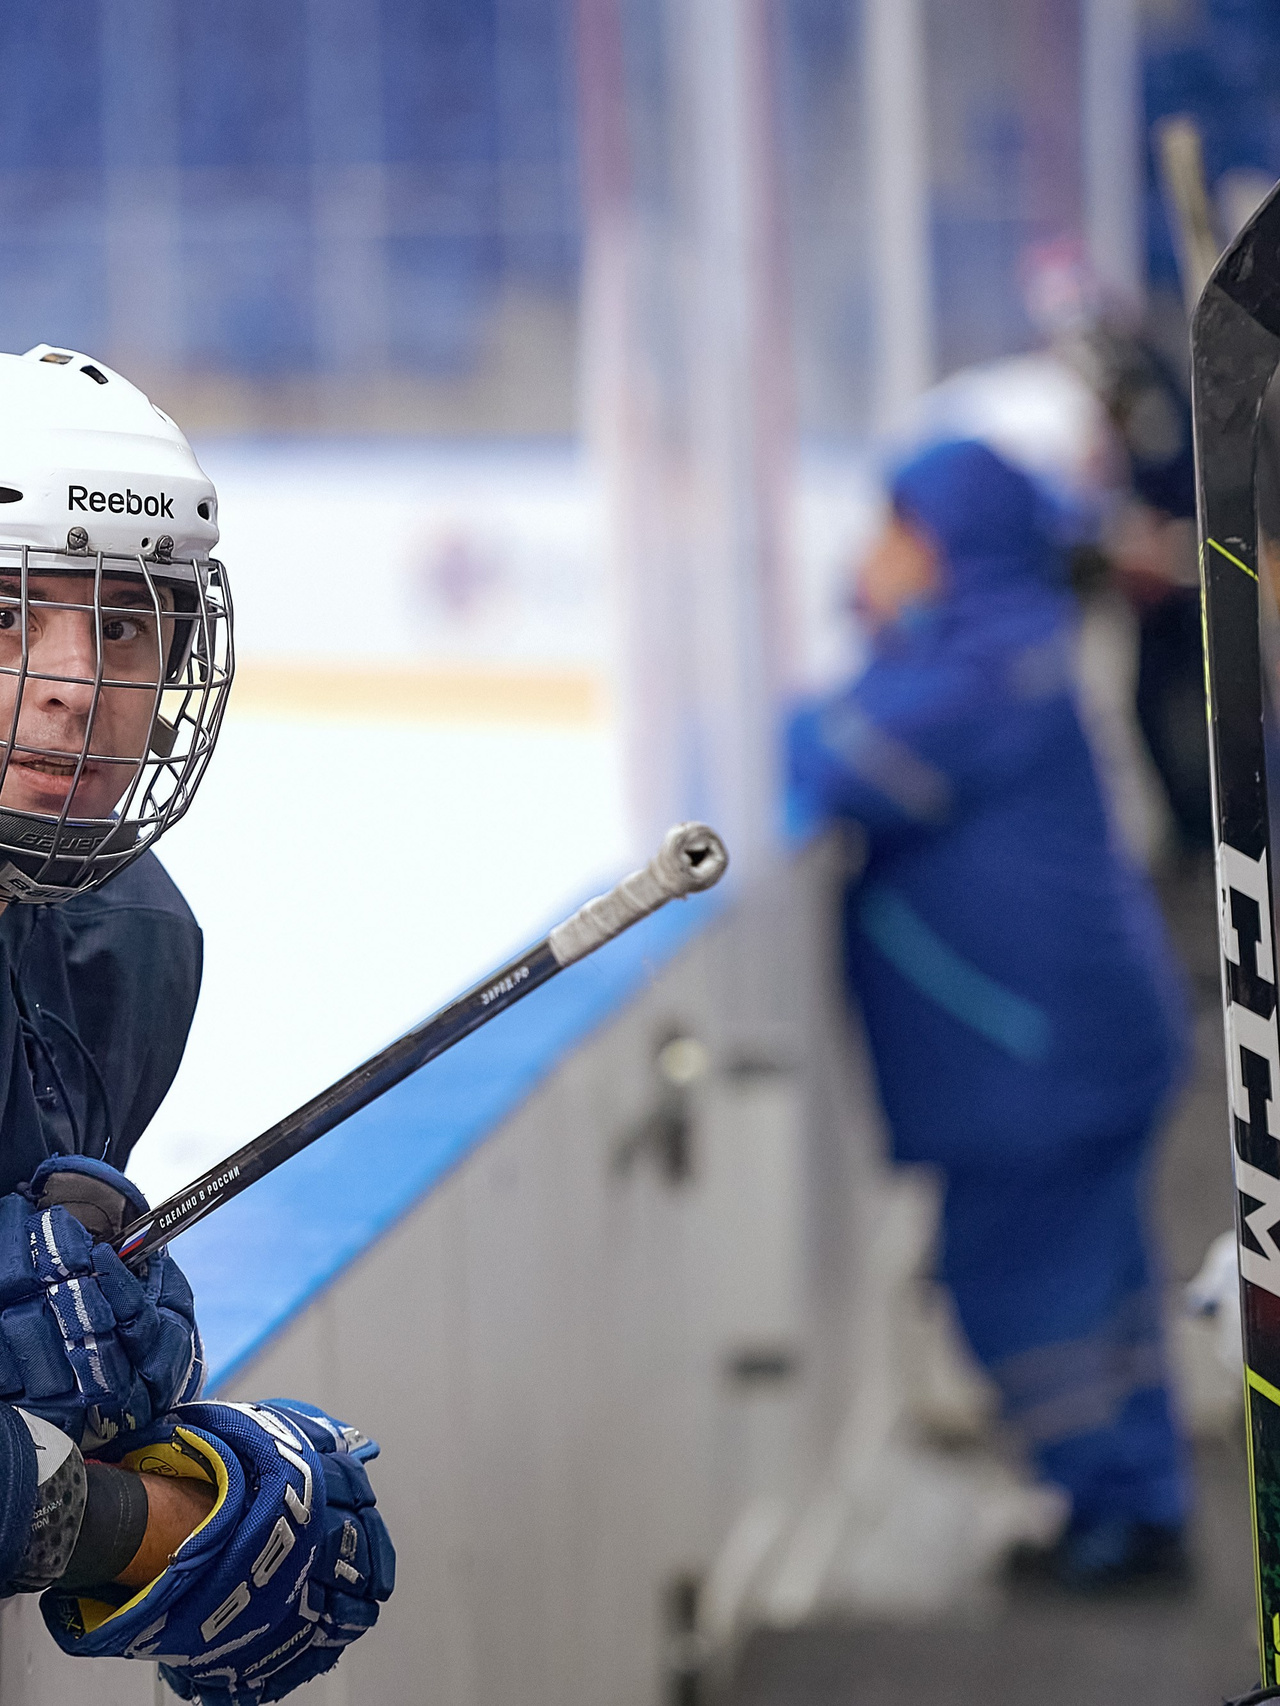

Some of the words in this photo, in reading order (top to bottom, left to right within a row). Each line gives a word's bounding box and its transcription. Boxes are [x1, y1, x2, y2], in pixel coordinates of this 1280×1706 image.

[68, 485, 175, 519] Reebok
[1218, 841, 1280, 1298] CCM
[159, 1195, 198, 1229] СДЕЛАНО
[199, 1190, 206, 1201] В
[207, 1165, 240, 1196] РОССИИ
